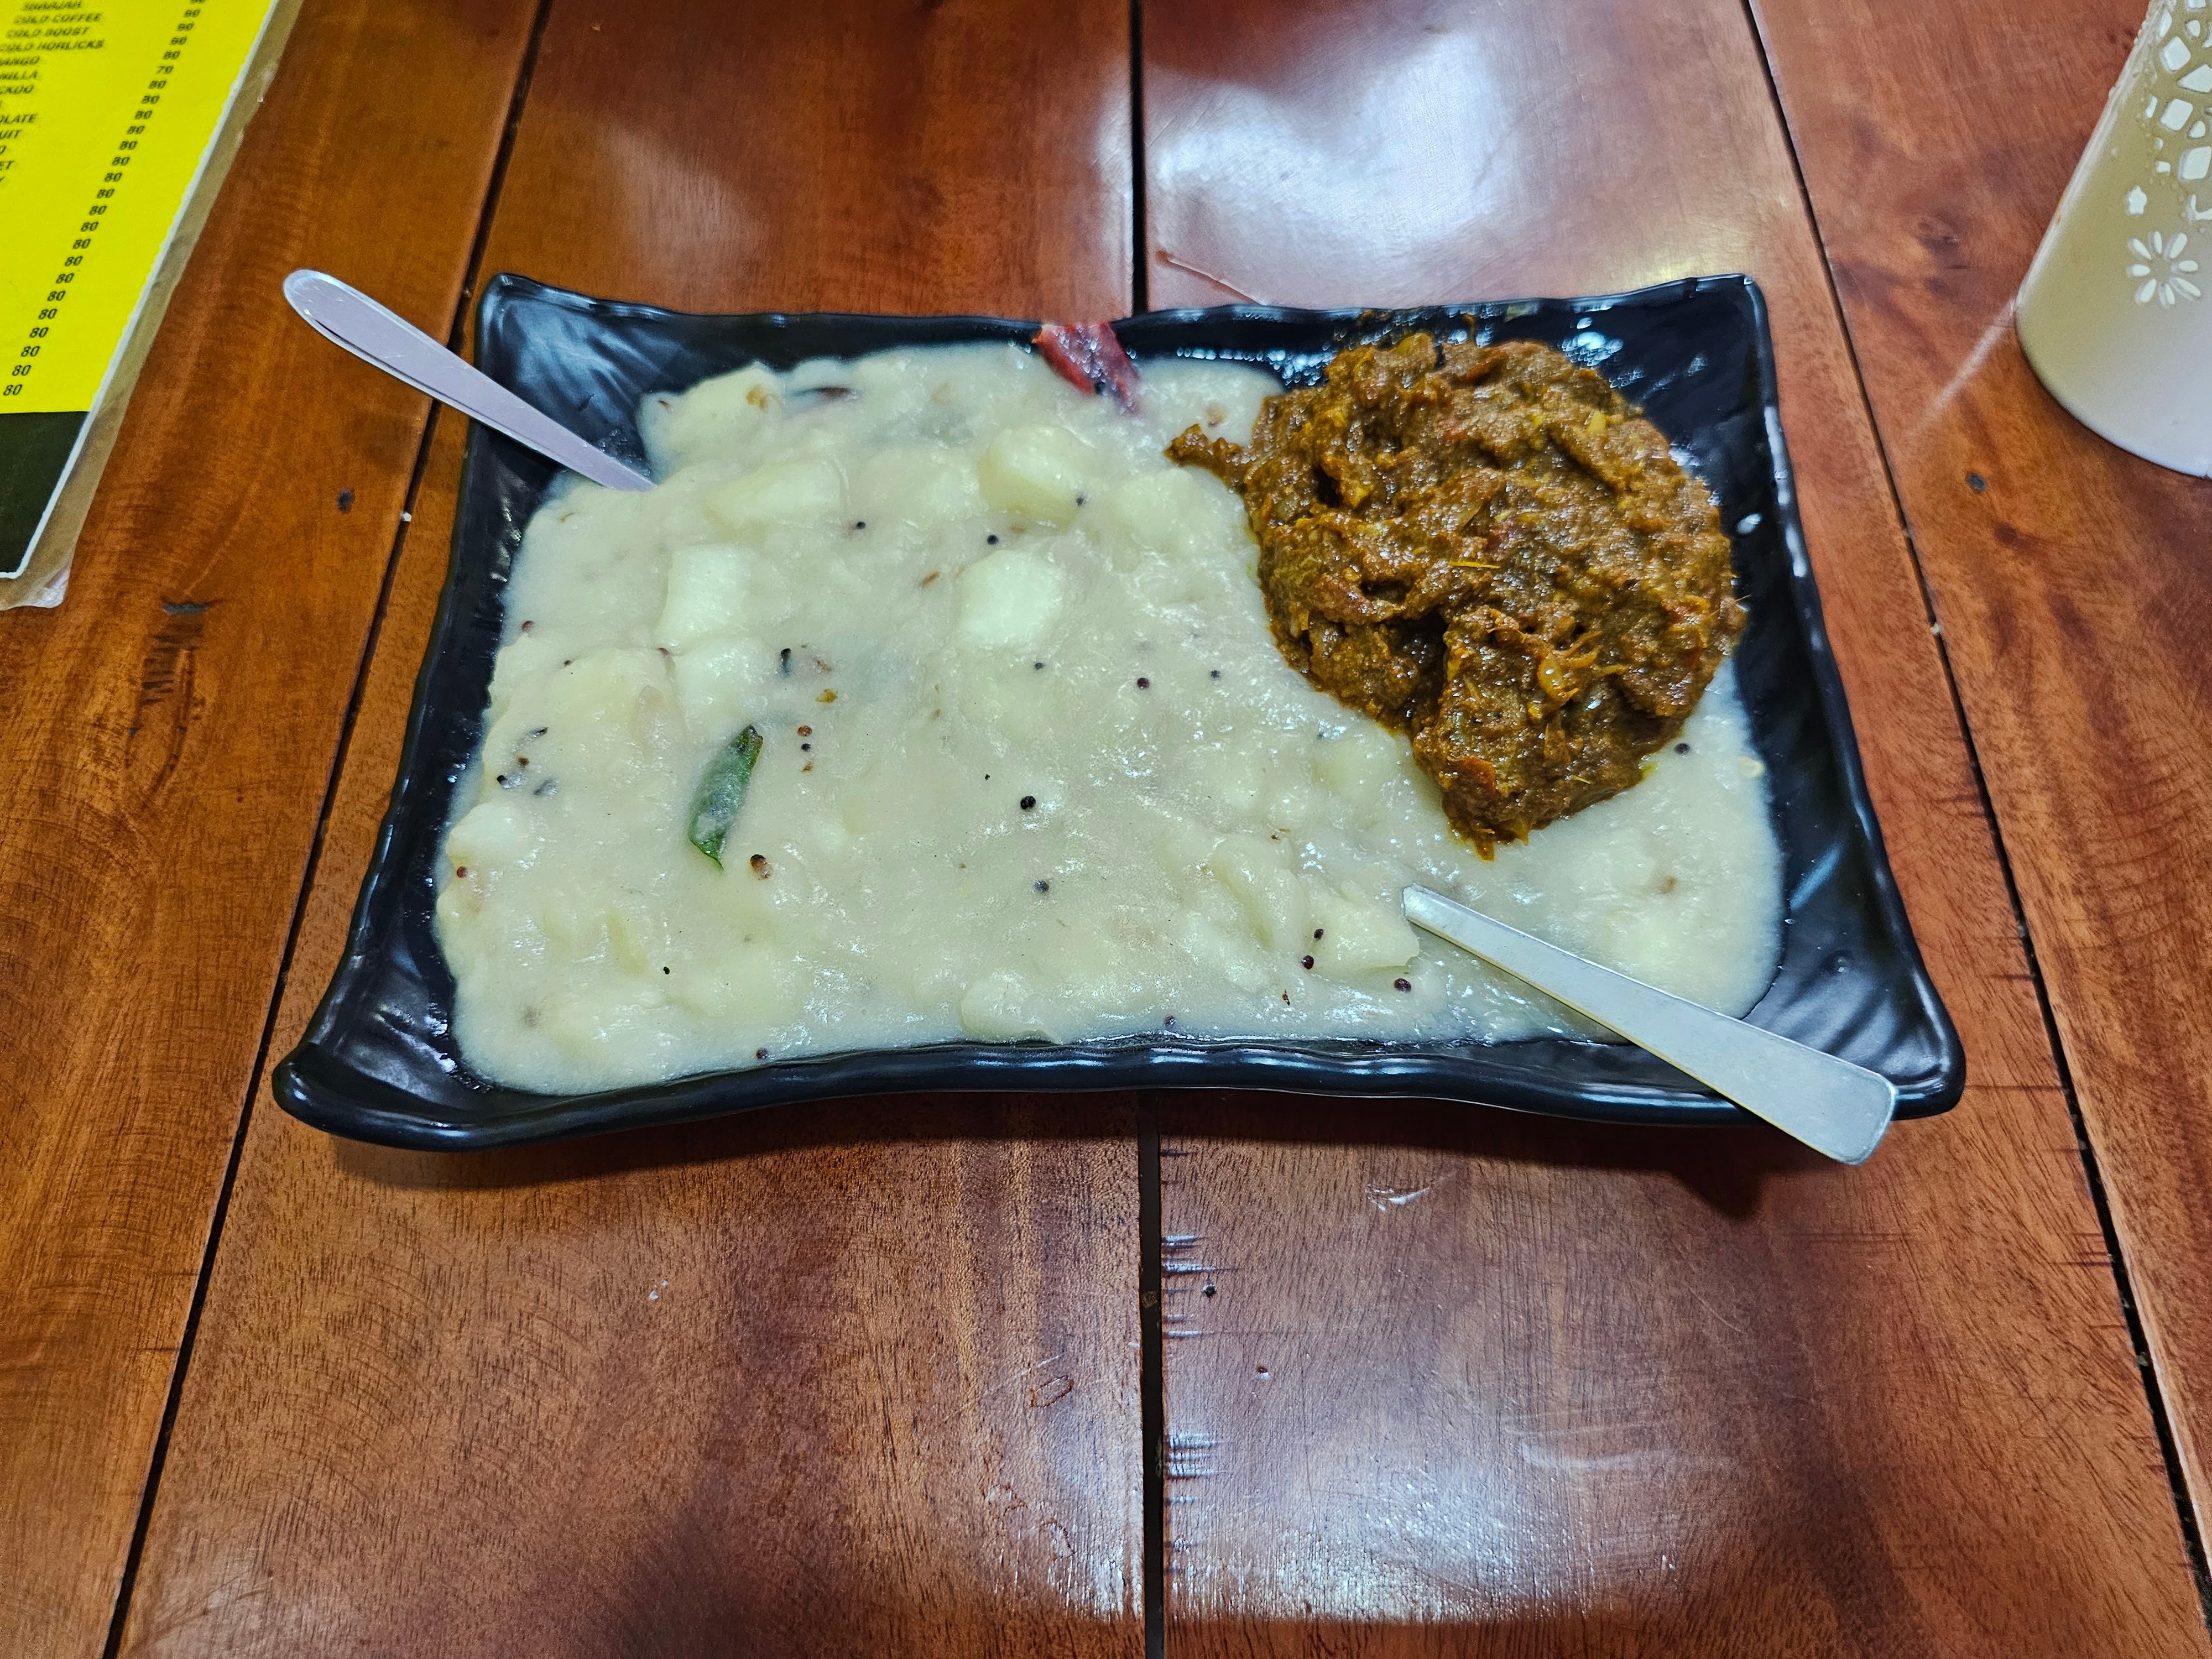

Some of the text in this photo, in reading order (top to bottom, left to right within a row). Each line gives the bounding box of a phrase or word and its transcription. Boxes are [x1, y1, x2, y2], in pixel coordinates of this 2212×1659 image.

[52, 13, 102, 23] COFFEE
[6, 29, 41, 39] COLD
[44, 27, 90, 37] BOOST
[36, 39, 105, 51] HORLICKS
[156, 66, 174, 75] 70
[149, 80, 166, 89] 80
[142, 95, 160, 105] 80
[134, 110, 152, 120] 80
[127, 125, 145, 134] 80
[119, 141, 138, 150] 80
[112, 156, 130, 166] 80
[105, 173, 122, 182] 80
[96, 189, 114, 199] 80
[89, 206, 107, 216] 80
[81, 222, 99, 232] 80
[72, 239, 91, 249] 80
[64, 256, 83, 267] 80
[56, 273, 75, 284] 80
[47, 291, 66, 301] 80
[38, 309, 58, 320] 80
[29, 327, 49, 338] 80
[21, 346, 40, 357] 80
[12, 365, 32, 376] 80
[3, 384, 23, 396] 80
